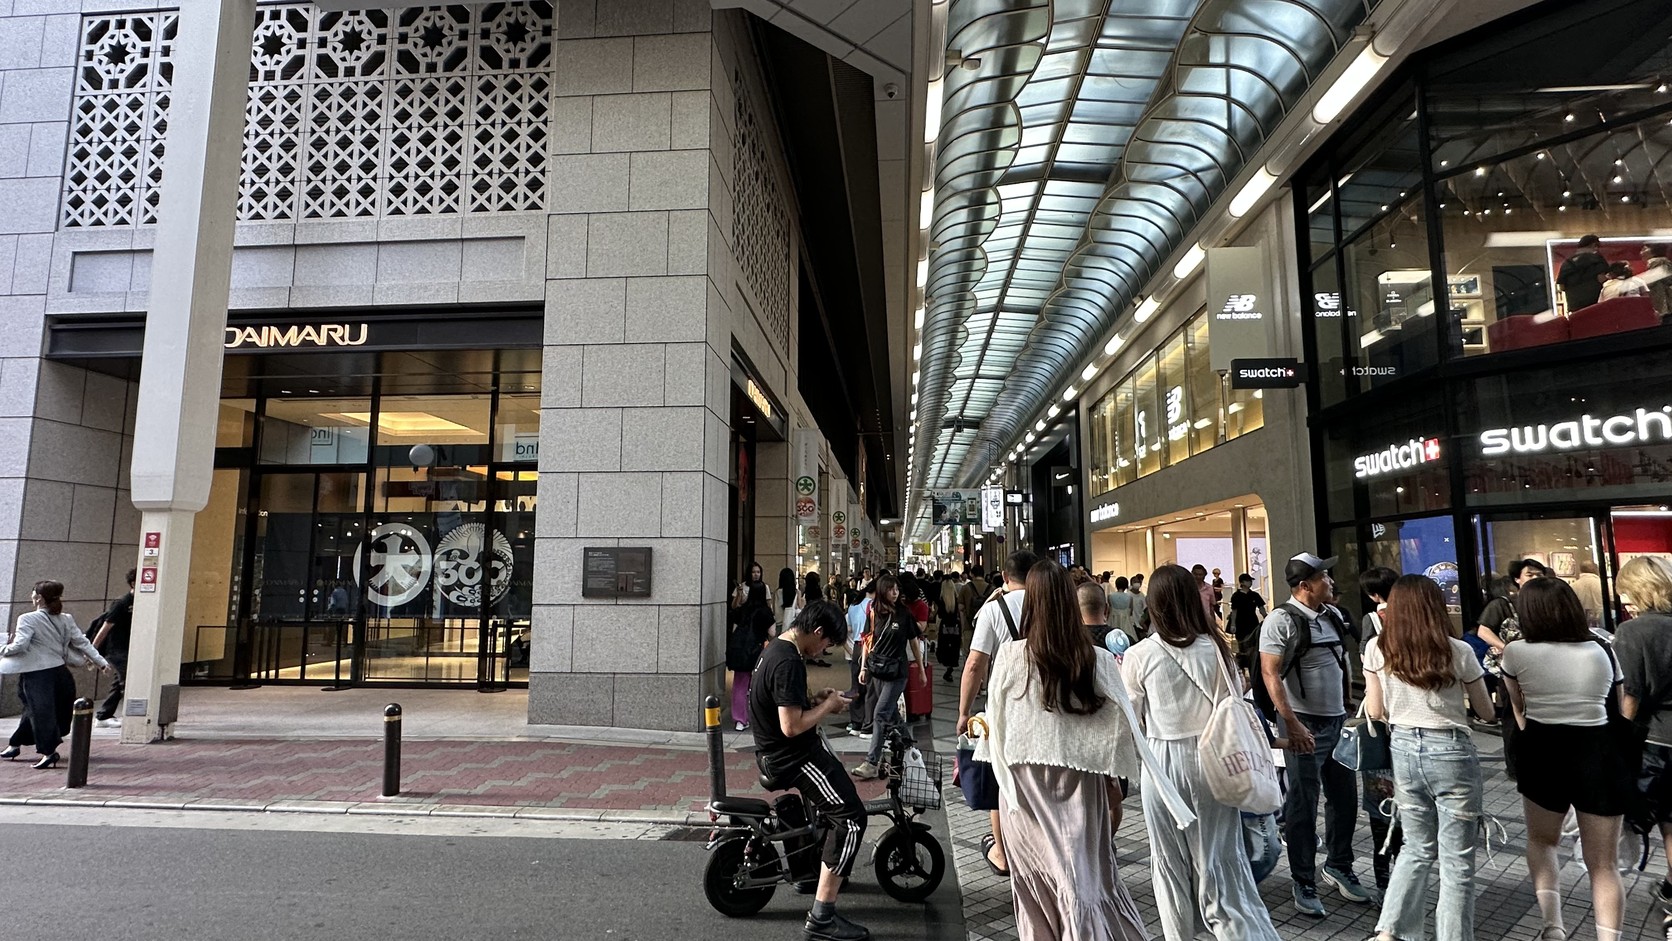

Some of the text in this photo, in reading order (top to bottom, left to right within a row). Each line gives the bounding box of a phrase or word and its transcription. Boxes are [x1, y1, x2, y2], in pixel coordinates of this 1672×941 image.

[1232, 312, 1262, 320] balance
[225, 323, 368, 347] DAIMARU
[1239, 367, 1286, 378] swatch
[1480, 405, 1672, 454] swatch
[1354, 436, 1425, 478] swatch
